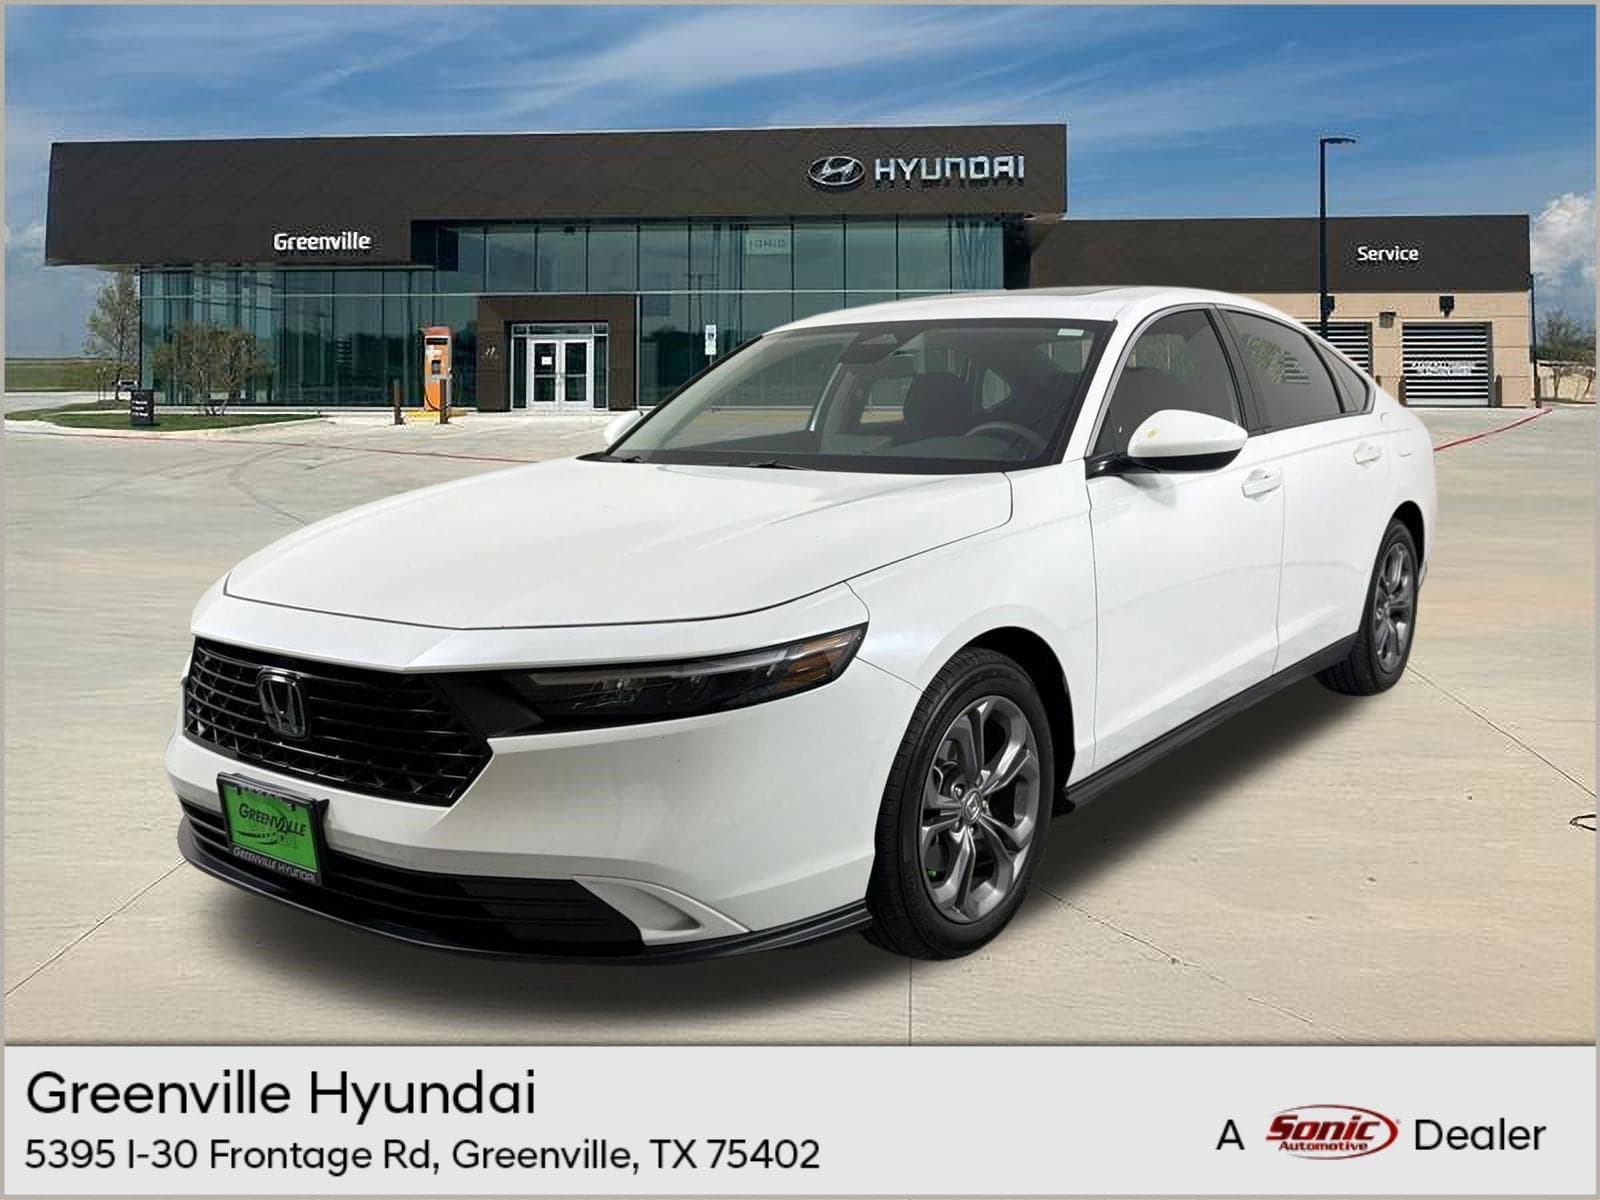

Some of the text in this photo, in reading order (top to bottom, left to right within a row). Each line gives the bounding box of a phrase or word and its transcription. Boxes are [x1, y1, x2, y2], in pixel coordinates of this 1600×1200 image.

[875, 155, 1025, 181] HYUNDAI
[273, 231, 371, 251] Greenville
[1356, 245, 1420, 262] Service
[239, 803, 307, 836] GREENVILLE
